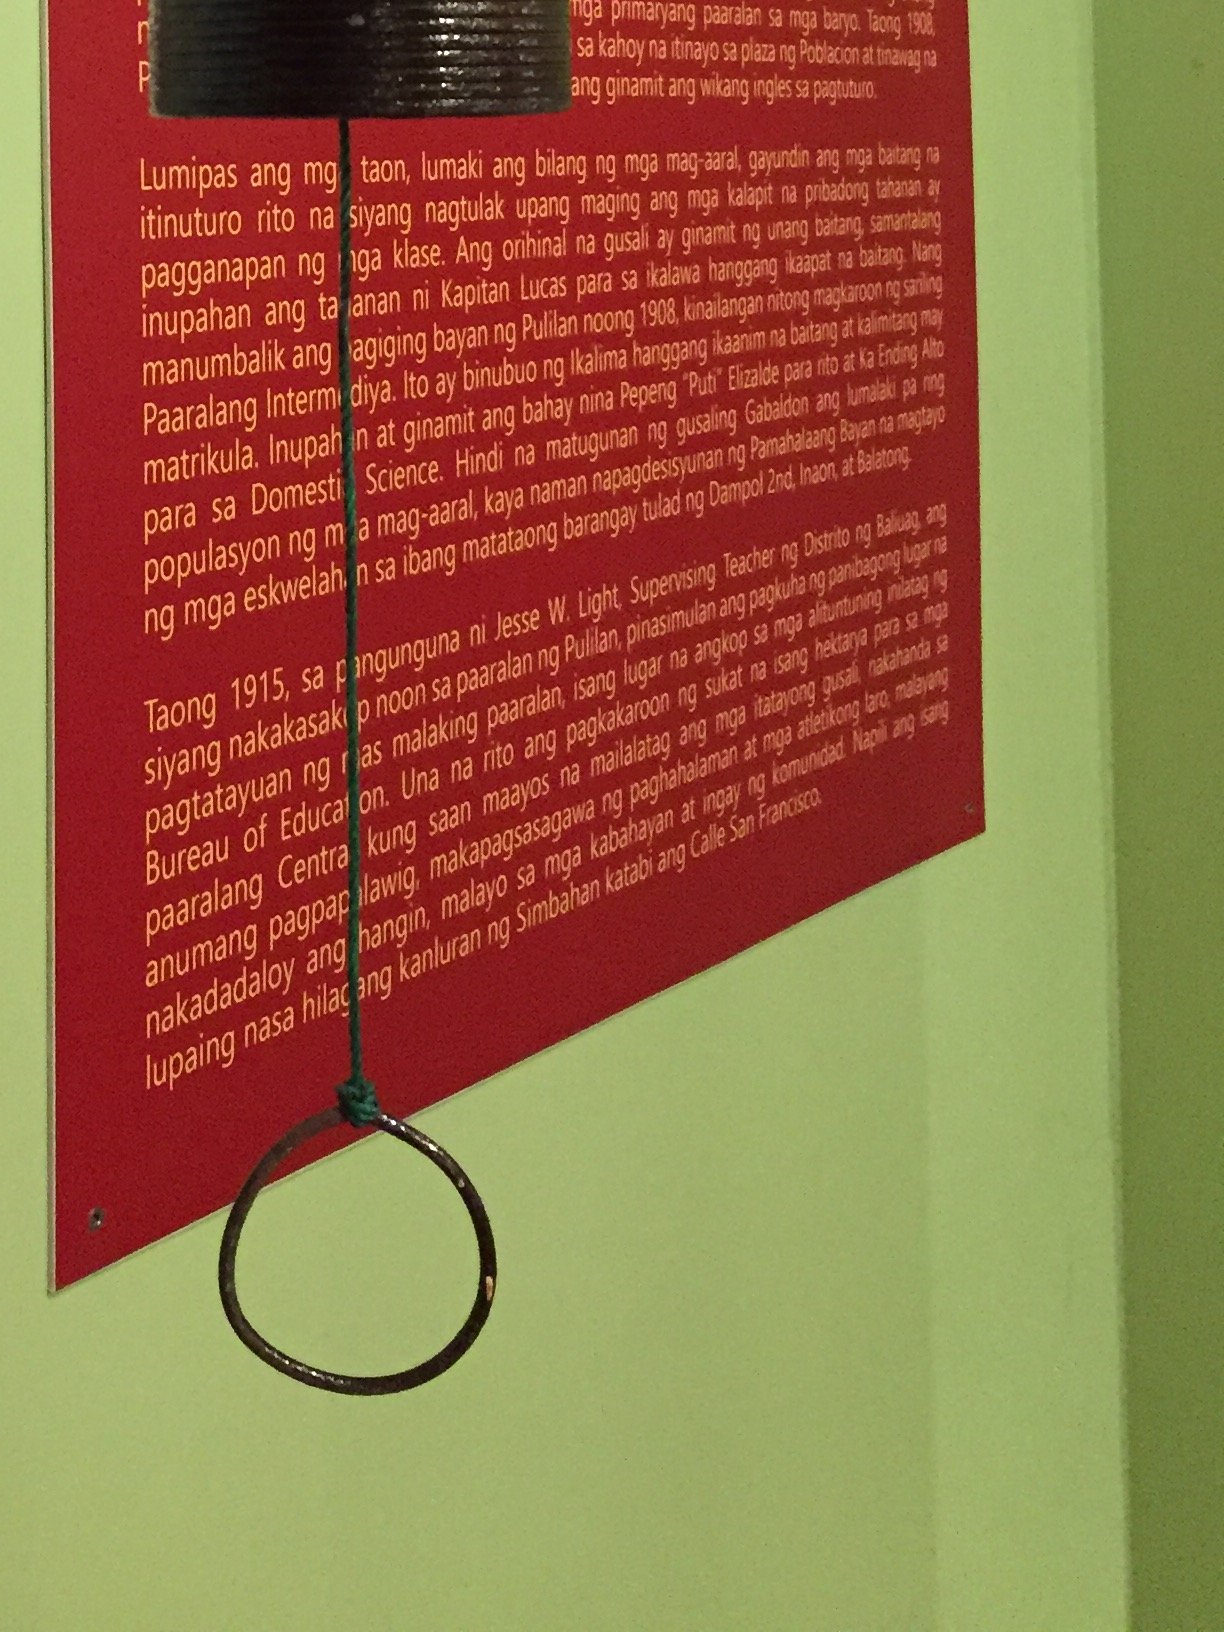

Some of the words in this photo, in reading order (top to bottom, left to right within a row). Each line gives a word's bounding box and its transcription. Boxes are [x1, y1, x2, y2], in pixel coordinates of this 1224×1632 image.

[598, 29, 645, 67] kahoy
[648, 39, 667, 60] na
[671, 36, 720, 69] itinayo
[741, 36, 776, 69] plaza
[779, 44, 797, 71] ng
[799, 38, 860, 65] Poblacion
[605, 69, 665, 105] ginamit
[699, 71, 750, 106] wikang
[753, 73, 793, 106] ingles
[703, 0, 762, 31] paaralan
[789, 9, 818, 36] mga
[140, 155, 238, 199] Lumipas
[250, 162, 291, 196] ang
[303, 160, 337, 194] mg
[360, 155, 411, 185] taon,
[421, 149, 483, 182] lumaki
[492, 156, 526, 187] ang
[535, 148, 588, 185] bilang
[624, 152, 659, 182] mga
[666, 144, 742, 180] mag-aaral,
[140, 204, 242, 240] itinuturo
[257, 200, 295, 233] rito
[350, 196, 412, 237] siyang
[425, 190, 505, 232] nagtulak
[515, 195, 570, 225] upang
[580, 185, 641, 223] maging
[141, 254, 286, 299] pagganapan
[298, 251, 325, 286] ng
[393, 238, 446, 269] klase.
[455, 235, 493, 272] Ang
[502, 227, 567, 262] orihinal
[603, 222, 649, 262] gusali
[142, 297, 251, 344] inupahan
[264, 299, 306, 334] ang
[318, 290, 401, 321] taanan
[413, 280, 429, 311] ni
[441, 279, 510, 314] Kapitan
[520, 273, 567, 301] Lucas
[576, 272, 613, 303] para
[142, 338, 286, 387] manumbalik
[433, 321, 488, 359] bayan
[522, 309, 578, 341] Pulilan
[583, 308, 635, 338] noong
[639, 297, 679, 327] 1908,
[143, 393, 257, 436] Paaralang
[266, 374, 396, 419] Intermdiya.
[403, 369, 429, 399] Ito
[463, 356, 537, 392] binubuo
[570, 345, 627, 375] Ikalima
[632, 337, 708, 372] hanggang
[143, 437, 259, 485] matrikula.
[269, 423, 368, 469] Inupahn
[403, 404, 475, 453] ginamit
[522, 392, 574, 427] bahay
[579, 384, 614, 414] nina
[620, 380, 677, 413] Pepeng
[144, 502, 197, 546] para
[251, 467, 341, 516] Domesti
[365, 459, 444, 495] Science.
[455, 440, 503, 478] Hindi
[546, 425, 639, 463] matugunan
[675, 404, 737, 446] gusaling
[744, 392, 809, 425] Gabaldon
[144, 534, 280, 595] populasyon
[377, 488, 478, 540] mag-aaral,
[484, 485, 524, 520] kaya
[530, 474, 588, 506] naman
[592, 447, 724, 496] napagdesisyunan
[144, 604, 175, 642] ng
[184, 591, 236, 631] mga
[403, 543, 456, 577] ibang
[462, 521, 558, 563] matataong
[563, 504, 638, 540] barangay
[642, 487, 681, 522] tulad
[709, 469, 764, 507] Dampol
[143, 692, 216, 734] Taong
[230, 666, 290, 710] 1915,
[469, 614, 486, 647] ni
[494, 608, 541, 642] Jesse
[578, 583, 623, 624] Light,
[630, 559, 717, 607] Supervising
[722, 545, 776, 578] Teacher
[144, 740, 221, 791] siyang
[376, 682, 426, 718] noon
[456, 650, 533, 703] paaralan
[564, 626, 622, 663] Pulilan,
[626, 598, 717, 653] pinasimulan
[145, 768, 292, 846] pagtatayuan
[392, 711, 478, 758] malaking
[487, 684, 566, 736] paaralan,
[146, 835, 229, 886] Bureau
[243, 812, 268, 853] of
[401, 767, 440, 800] Una
[524, 728, 557, 761] ang
[145, 923, 257, 988] anumang
[430, 798, 596, 880] makapagsasagawa
[146, 873, 263, 948] paaralang
[367, 820, 417, 858] kung
[428, 800, 472, 837] saan
[482, 772, 550, 816] maayos
[146, 957, 296, 1039] nakadadaloy
[306, 937, 346, 975] ang
[441, 874, 508, 920] malayo
[146, 1030, 235, 1091] lupaing
[244, 1006, 295, 1048] nasa
[399, 928, 481, 983] kanluran
[516, 878, 600, 933] Simbahan
[605, 848, 653, 895] katabi
[690, 823, 726, 858] Calle
